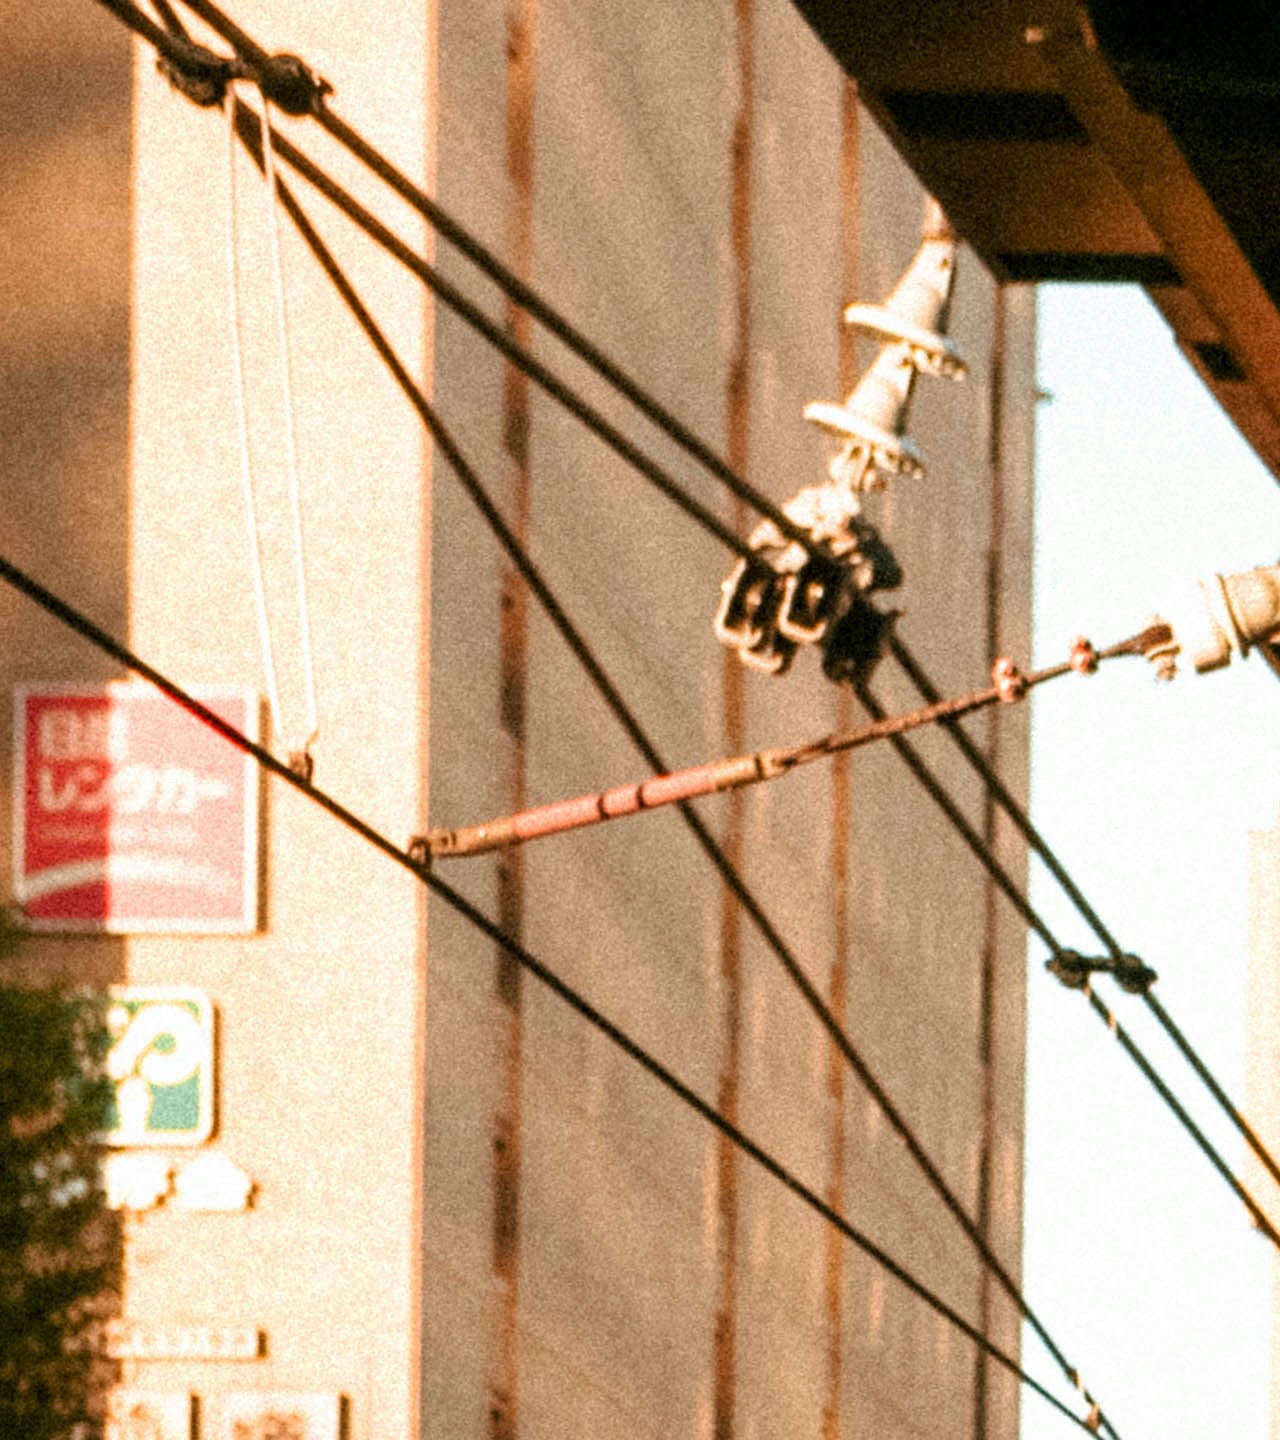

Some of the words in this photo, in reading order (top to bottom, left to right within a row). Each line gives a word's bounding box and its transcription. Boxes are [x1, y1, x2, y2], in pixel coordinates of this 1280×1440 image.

[39, 764, 231, 812] レンタカー
